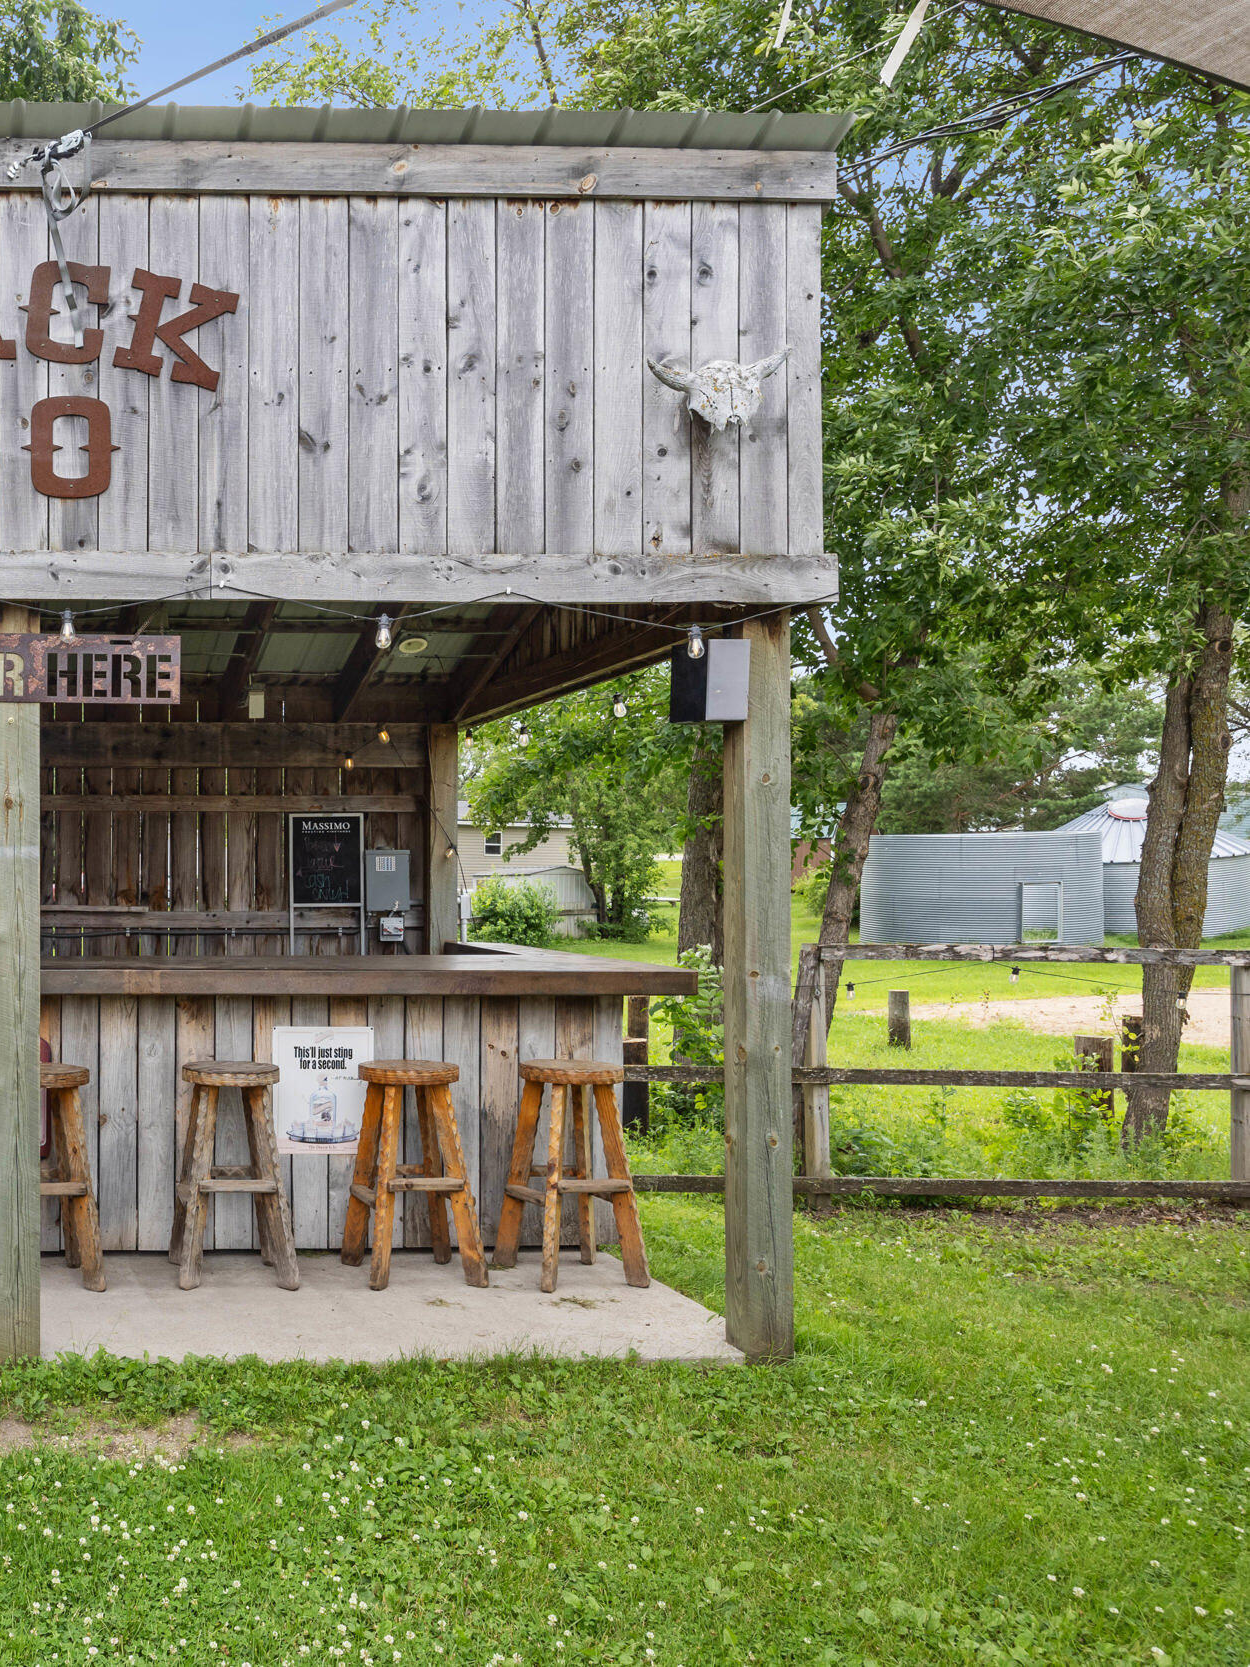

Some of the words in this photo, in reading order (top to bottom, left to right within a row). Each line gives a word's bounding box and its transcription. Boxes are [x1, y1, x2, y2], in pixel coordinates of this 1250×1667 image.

[47, 652, 172, 698] HERE
[293, 1046, 316, 1058] This'll
[318, 1046, 332, 1059] just
[333, 1046, 353, 1060] sting
[299, 1058, 310, 1069] for
[311, 1060, 317, 1069] a
[318, 1058, 347, 1070] second.
